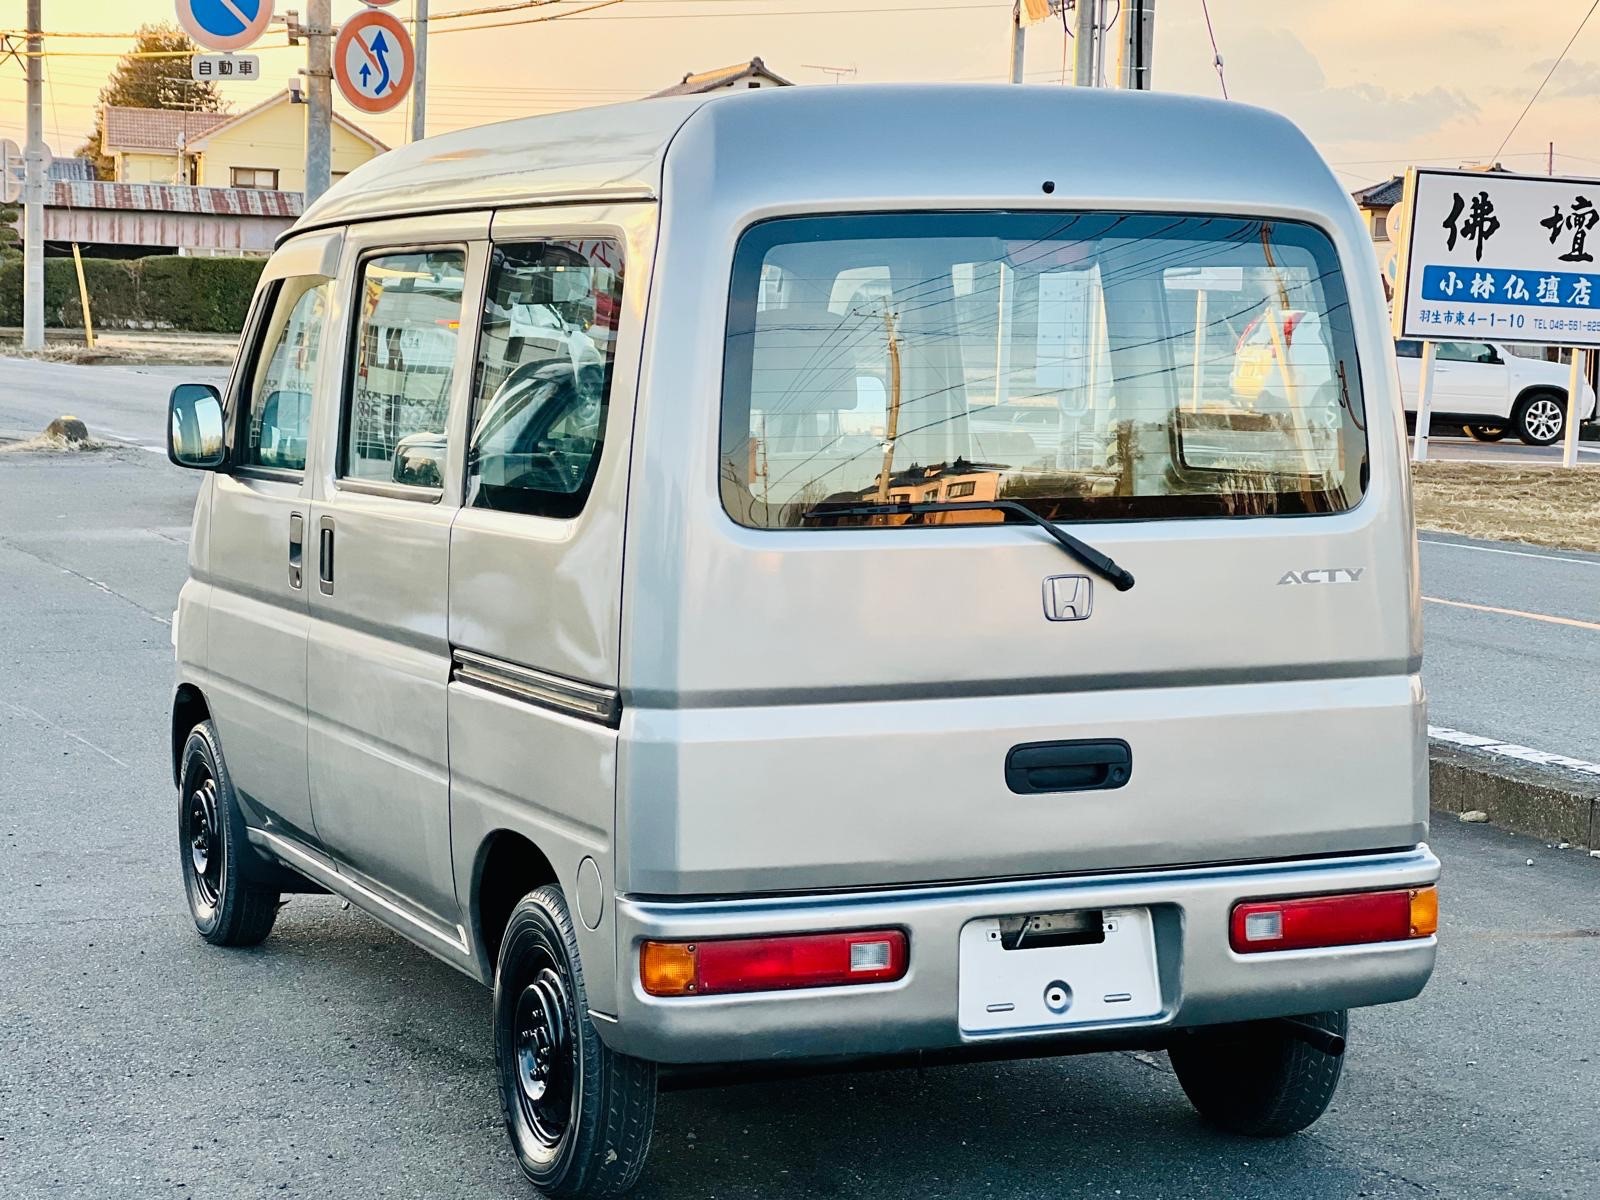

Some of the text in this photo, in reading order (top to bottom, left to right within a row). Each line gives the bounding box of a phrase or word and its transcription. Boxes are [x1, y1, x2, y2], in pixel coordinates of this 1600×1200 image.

[199, 60, 253, 75] 自動車
[1439, 271, 1592, 305] 小林仏壇店
[1534, 318, 1547, 330] TEL
[1276, 567, 1365, 586] ACTY
